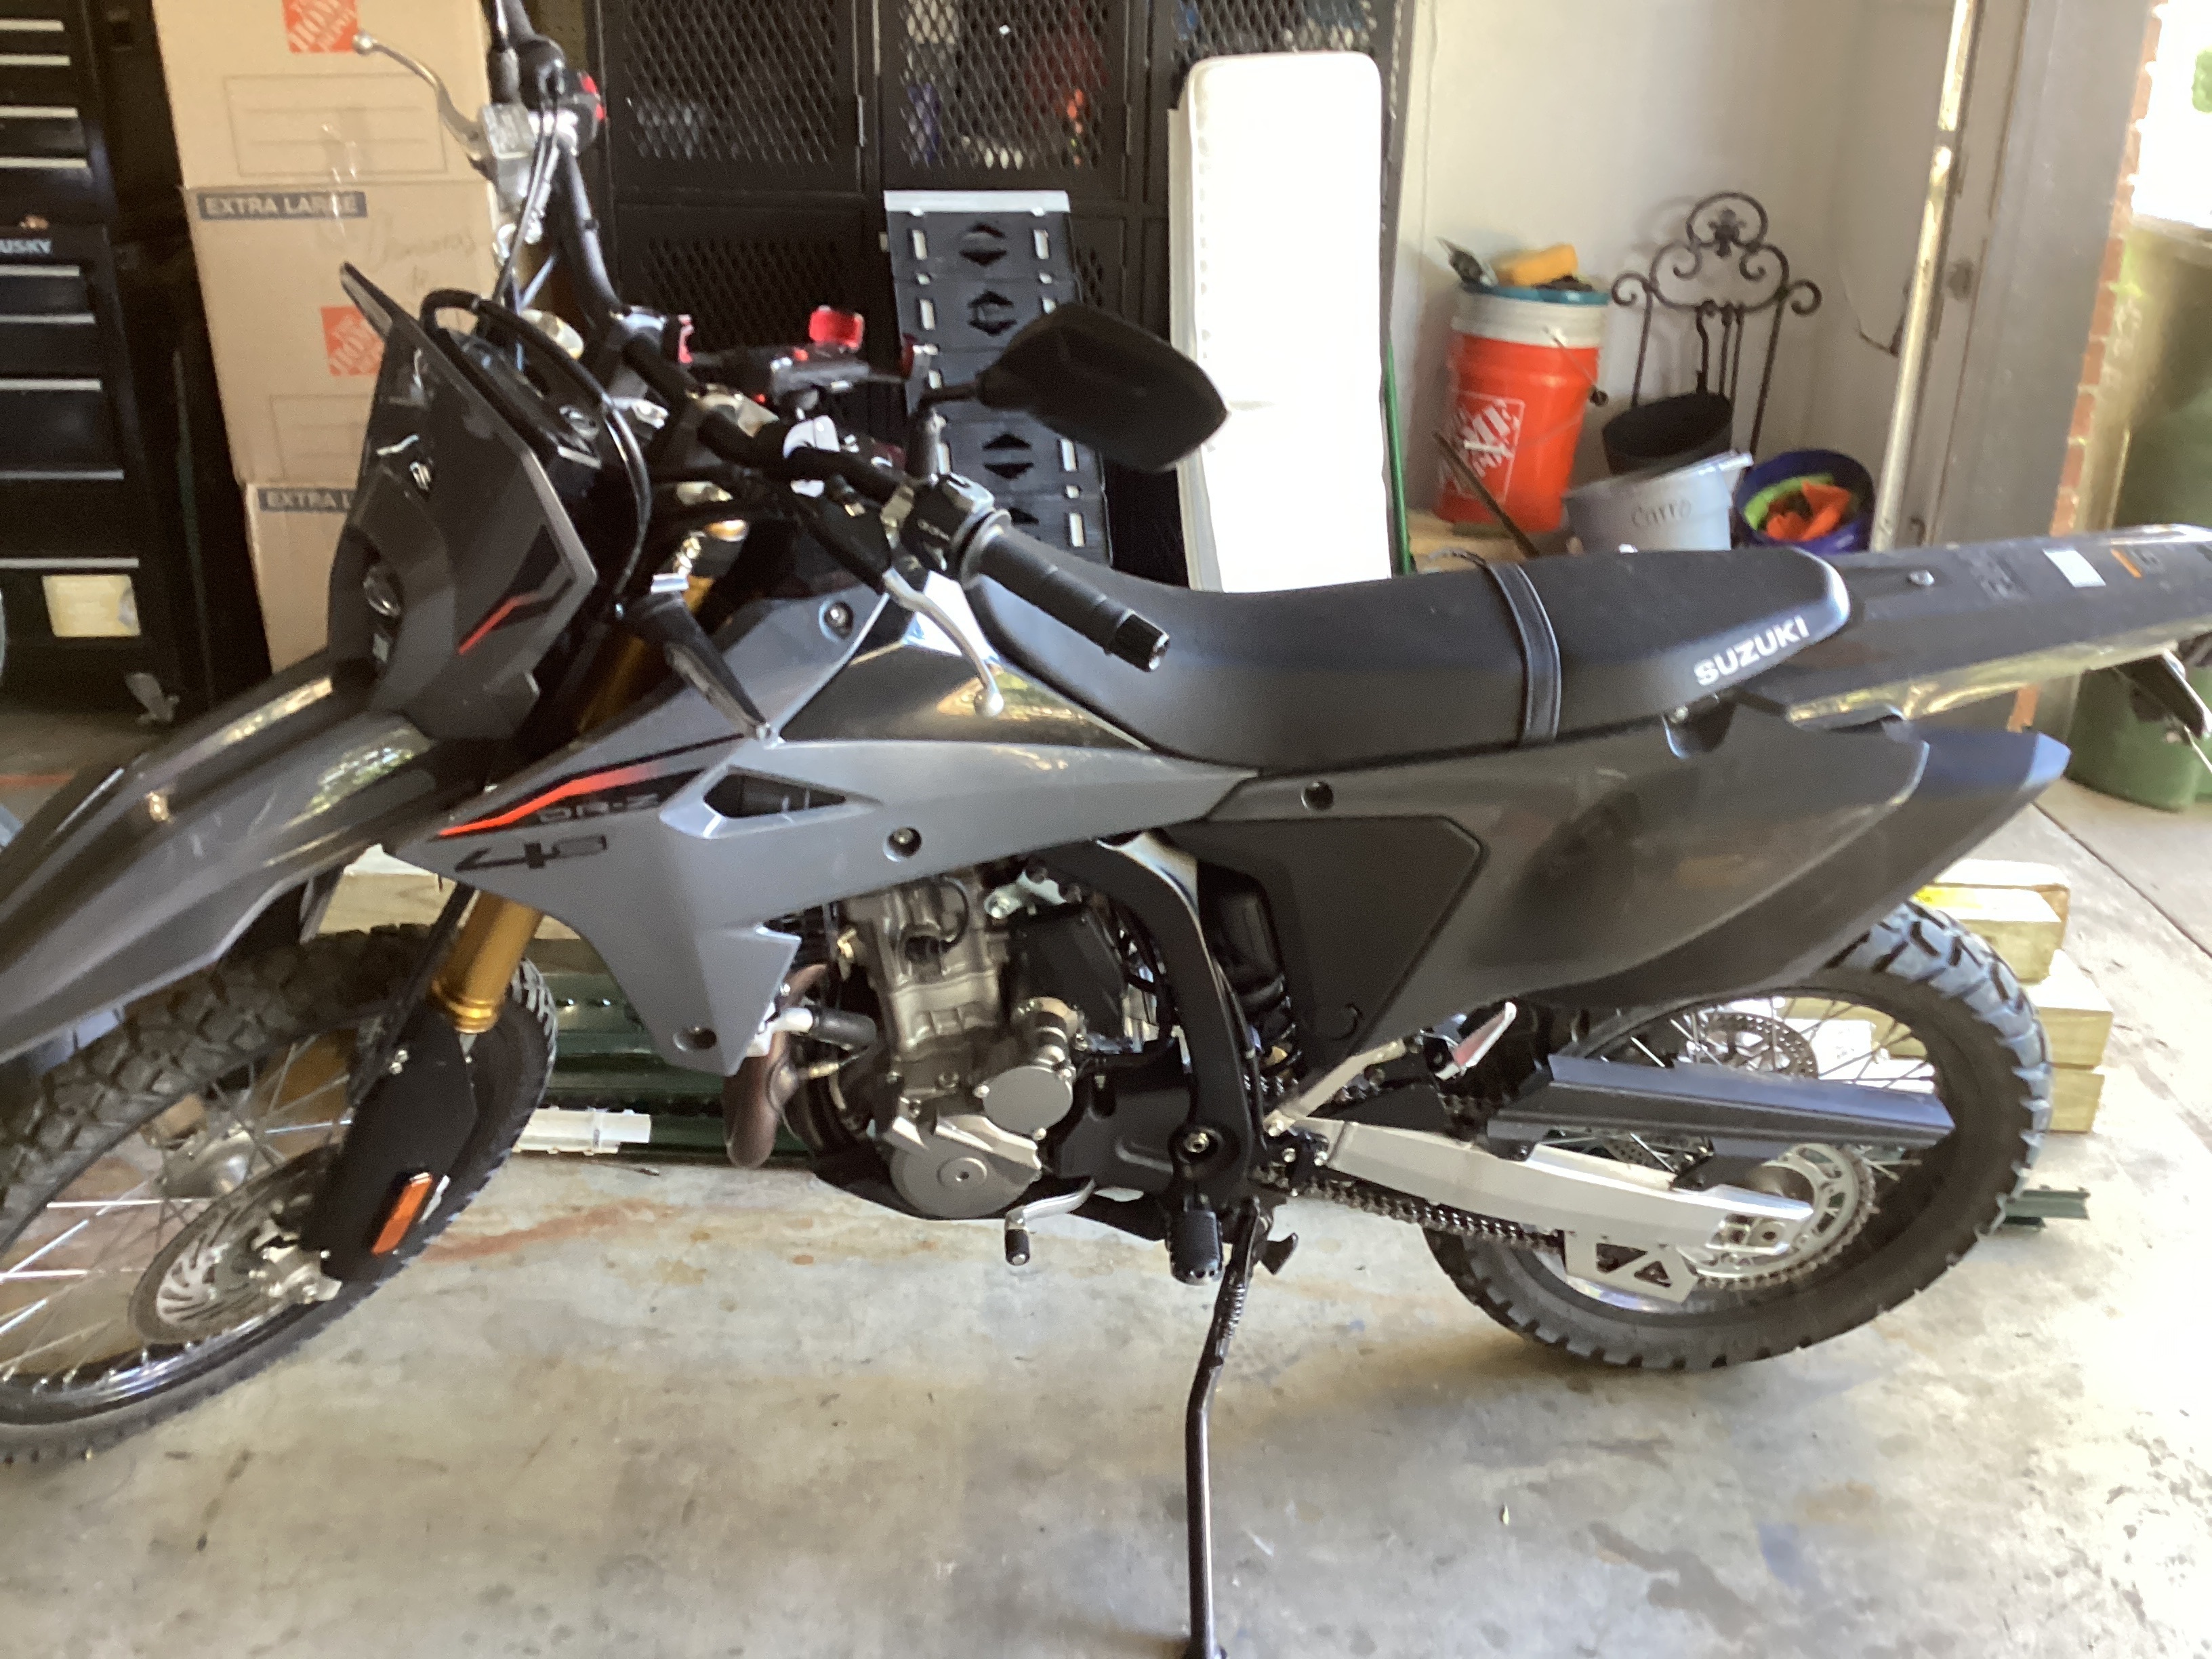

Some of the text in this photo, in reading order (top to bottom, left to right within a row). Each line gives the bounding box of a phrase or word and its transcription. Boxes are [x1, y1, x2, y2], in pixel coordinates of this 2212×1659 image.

[205, 196, 279, 215] EXTRA
[0, 239, 52, 254] USKY
[266, 491, 337, 508] EXTRA
[1694, 614, 1810, 687] SUZUKI
